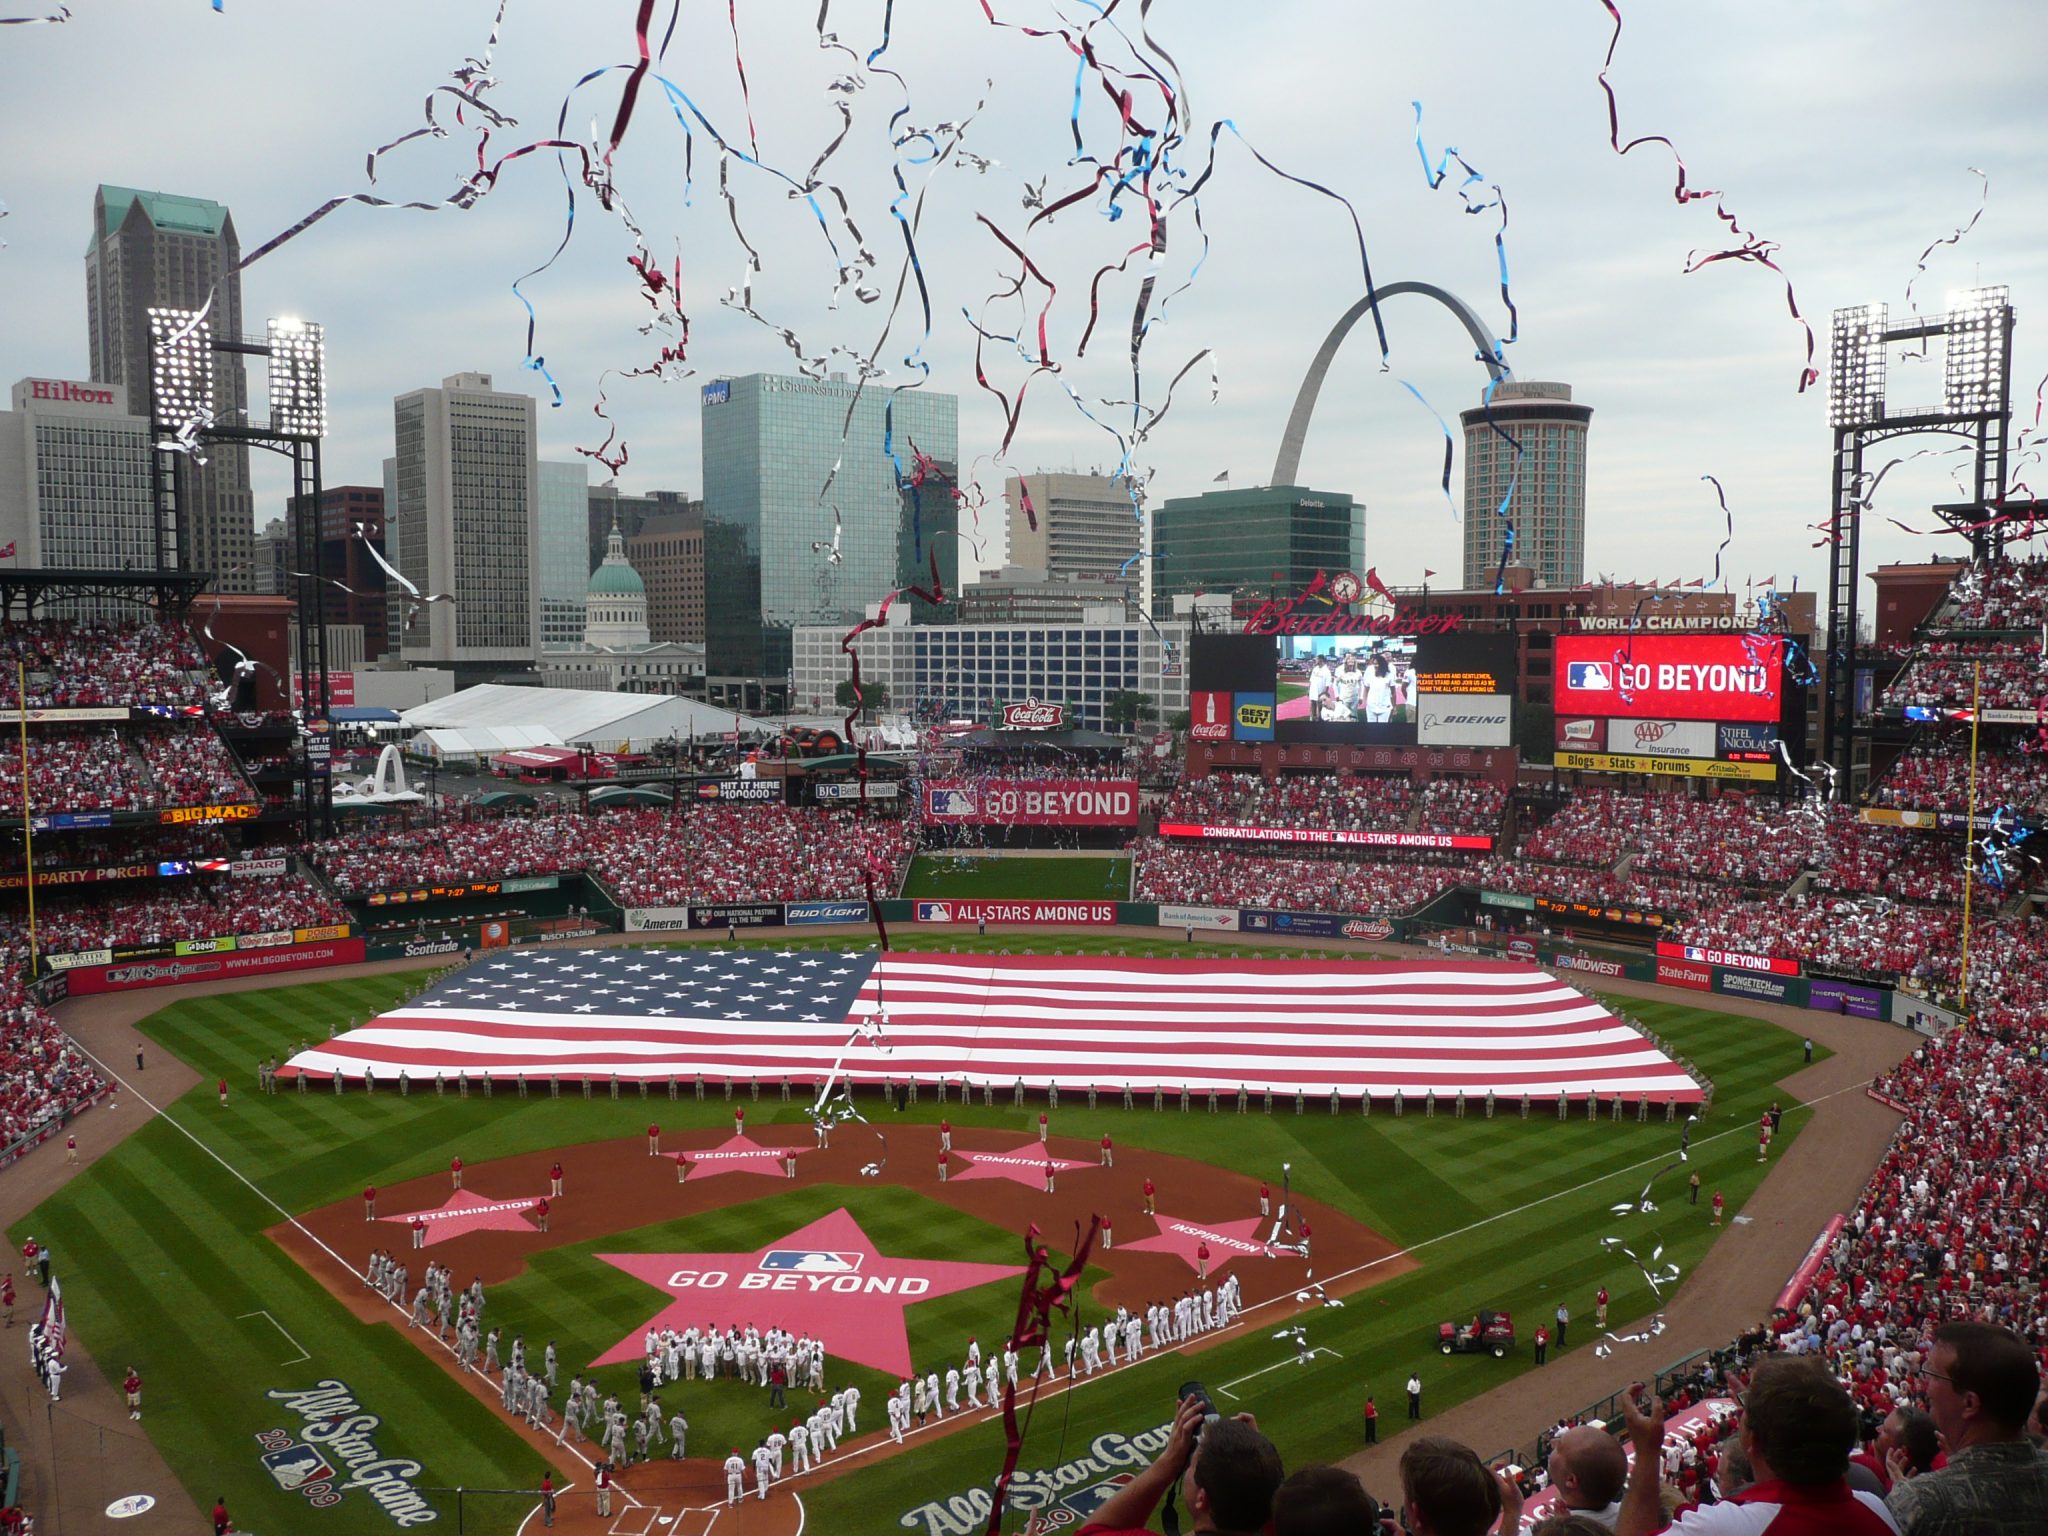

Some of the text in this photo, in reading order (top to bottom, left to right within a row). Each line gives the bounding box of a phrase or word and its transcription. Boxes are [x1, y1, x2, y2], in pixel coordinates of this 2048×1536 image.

[31, 380, 114, 404] Hilton
[702, 389, 726, 406] KPMG
[1231, 597, 1465, 636] Budweiser
[1578, 615, 1758, 630] WORLD CHAMPIONS
[1618, 663, 1768, 693] GO BEYOND
[1241, 707, 1271, 717] BEST
[1241, 716, 1268, 725] BUY
[1443, 715, 1507, 724] BOEING
[1720, 727, 1752, 738] STIFEL
[308, 744, 330, 752] HERE
[1253, 748, 1262, 761] 2
[1648, 744, 1691, 755] Insurance
[1277, 749, 1286, 762] 6
[1302, 750, 1311, 762] 9
[1326, 750, 1339, 763] 14
[1351, 752, 1364, 764] 17
[1374, 752, 1391, 765] 20
[1401, 752, 1418, 765] 42
[1567, 755, 1691, 772] Blogs Stats Forums
[720, 781, 780, 790] HIT IT HERE
[818, 785, 896, 798] BJC Bette Health
[985, 791, 1131, 816] GO BEYOND
[171, 804, 249, 823] BIG MAC
[198, 817, 224, 825] LAND
[1202, 827, 1293, 840] CONGRATULATIONS
[1294, 830, 1307, 841] TO
[1309, 831, 1329, 842] THE
[1399, 834, 1436, 846] AMONG
[1438, 836, 1453, 847] US
[233, 860, 285, 872] SHARP
[39, 870, 89, 885] PARTY
[96, 865, 148, 881] PORCH
[447, 888, 465, 897] 7:27
[727, 909, 754, 917] NATIONAL
[754, 908, 777, 916] PASTIME
[789, 907, 866, 918] BUD LIGHT
[957, 905, 1112, 921] ALL-STARS AMONG US
[1551, 903, 1567, 912] 7:27
[729, 916, 738, 924] ALL
[750, 915, 763, 923] TIME
[1163, 911, 1179, 921] Bank
[1186, 912, 1213, 922] America
[642, 918, 683, 930] Ameren
[306, 927, 339, 937] DOBBS
[540, 928, 596, 942] BUSCH STADIUM
[404, 940, 459, 957] Scottrade
[1450, 943, 1480, 954] STADIUM
[226, 948, 334, 968] WWW.MLBGOBEYOND.COM
[1707, 950, 1771, 970] GO BEYOND
[1571, 957, 1622, 976] MIDWEST
[1658, 965, 1709, 983] State Farm
[1723, 973, 1785, 993] SPONGETECH.com
[693, 1149, 782, 1160] DEDICATION
[972, 1154, 1069, 1170] COMMITMENT
[407, 1200, 534, 1223] DETERMINATION
[1168, 1222, 1262, 1255] INSPIRATION
[666, 1270, 931, 1296] GO BEYOND
[267, 1379, 438, 1528] All Star Game
[255, 1428, 343, 1508] 20 09
[900, 1457, 1112, 1536] All Star
